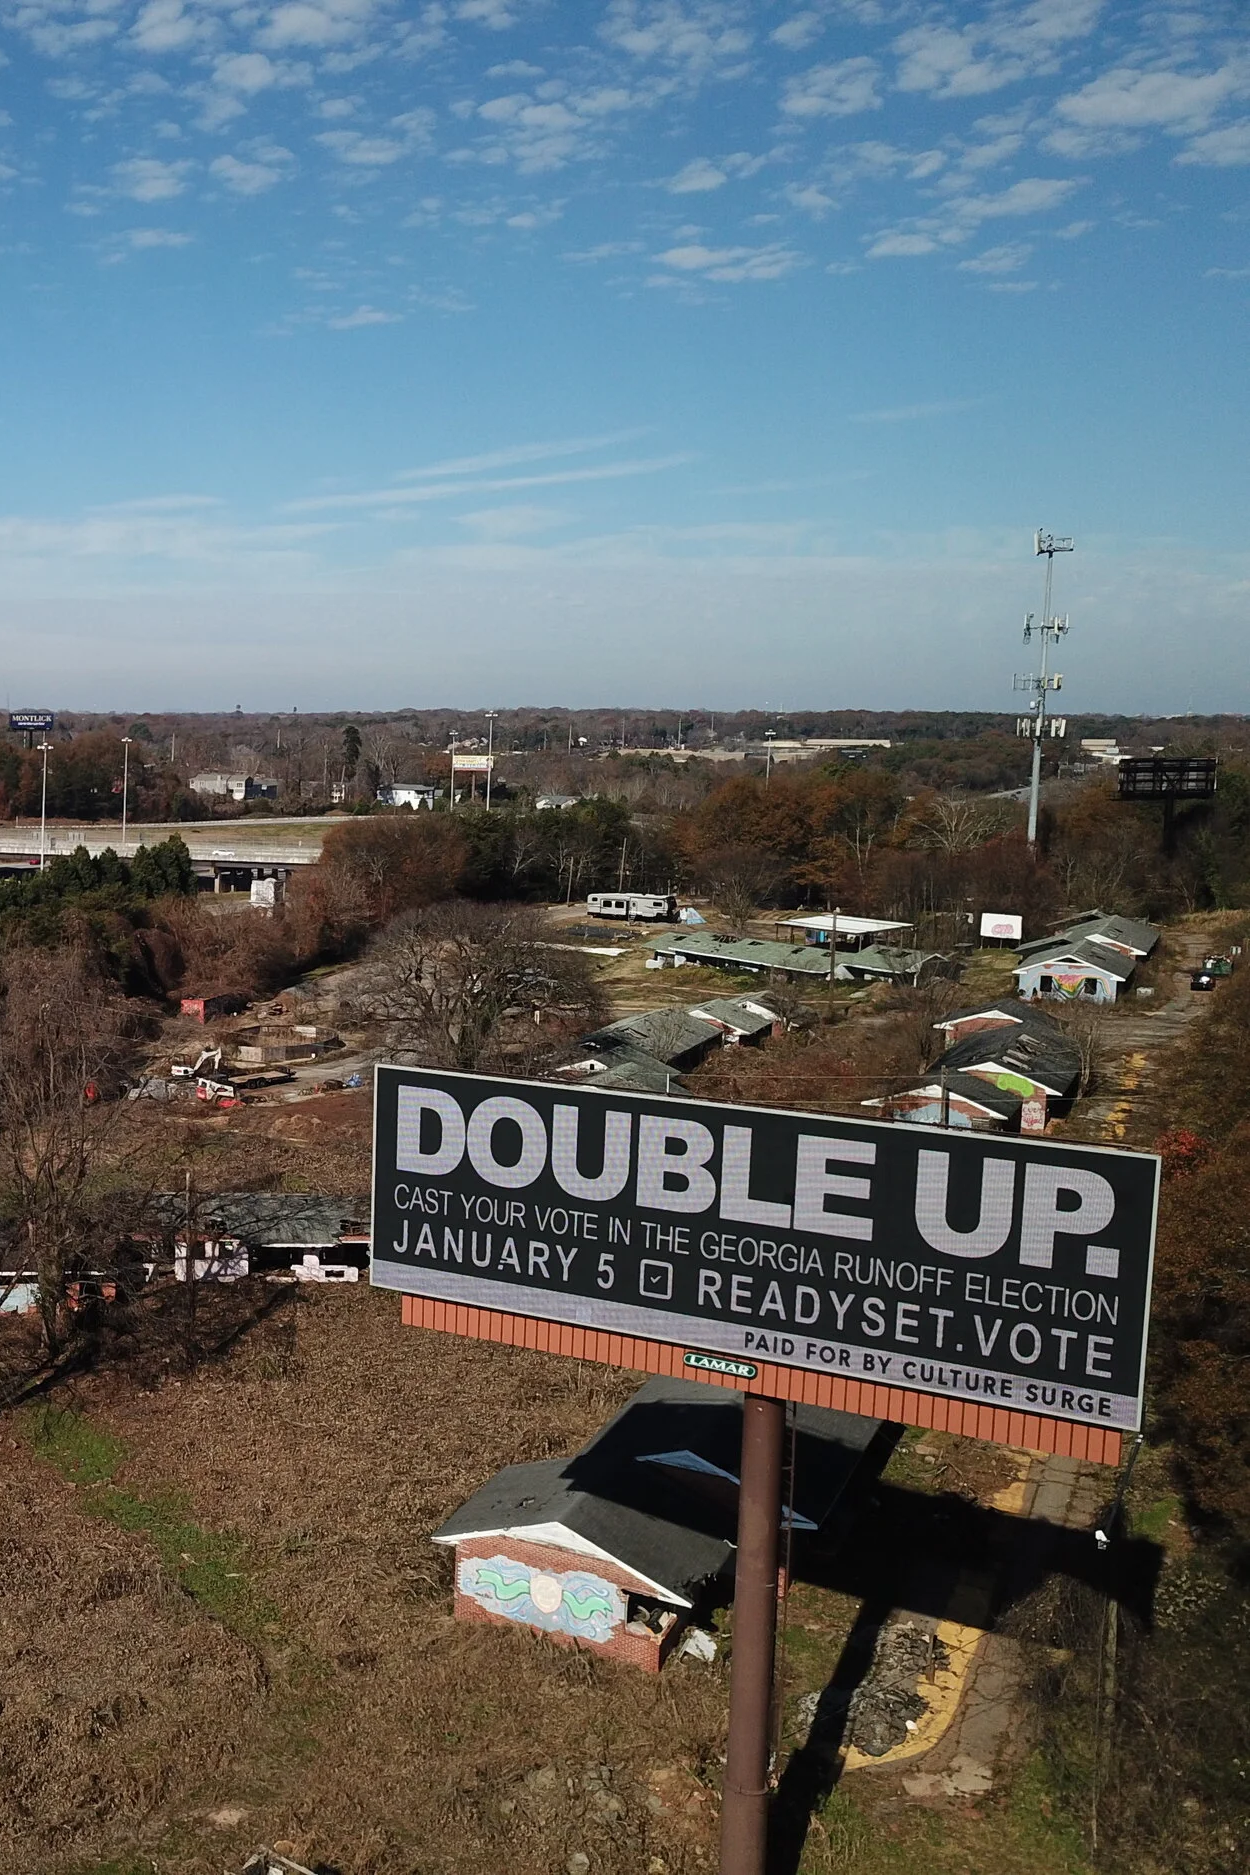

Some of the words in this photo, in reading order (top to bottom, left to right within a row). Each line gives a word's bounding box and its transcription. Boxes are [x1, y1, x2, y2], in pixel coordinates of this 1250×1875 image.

[396, 1084, 877, 1241] DOUBLE
[915, 1148, 1121, 1279] UP.
[392, 1219, 579, 1282] JANUARY
[596, 1252, 616, 1290] 5
[697, 1268, 1114, 1379] READYSET.VOTE
[394, 1184, 453, 1216] CAST
[460, 1193, 526, 1229] YOUR
[534, 1204, 599, 1241] VOTE
[608, 1216, 632, 1246] IN
[640, 1221, 691, 1255] THE
[700, 1231, 824, 1277] GEORGIA
[834, 1251, 955, 1297] RUNOFF
[964, 1271, 1120, 1327] ELECTION
[690, 1354, 750, 1376] LAMAR
[743, 1331, 795, 1355] PAID
[805, 1342, 851, 1369] FOR
[862, 1354, 893, 1376] BY
[902, 1361, 1014, 1399] CULTURE
[1025, 1383, 1113, 1418] SURGE
